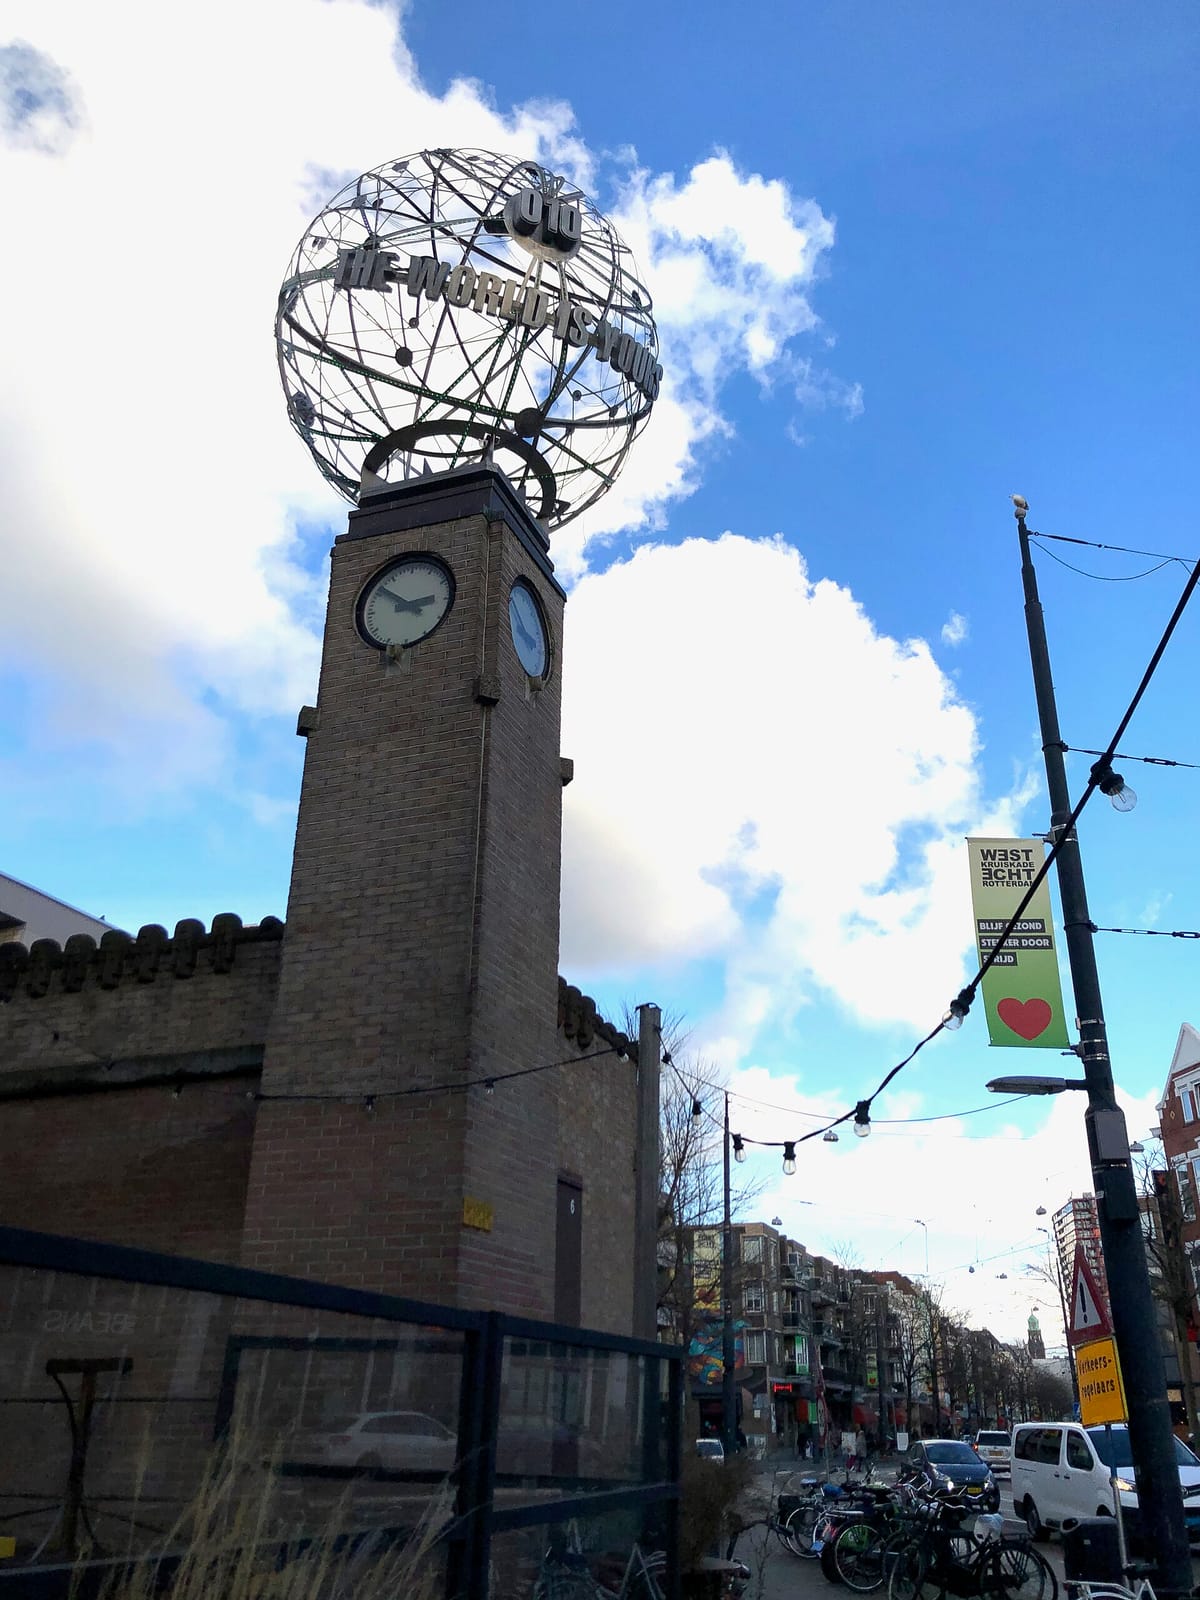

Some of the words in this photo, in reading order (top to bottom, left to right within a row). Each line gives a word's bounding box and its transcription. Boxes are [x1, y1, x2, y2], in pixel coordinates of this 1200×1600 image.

[515, 187, 582, 250] 010
[334, 248, 400, 293] THE
[407, 255, 548, 329] WORLD
[553, 300, 593, 348] IS
[594, 319, 664, 402] YOURS
[979, 922, 1004, 930] BLIJF
[981, 938, 1020, 946] STEKER
[1022, 938, 1050, 946] DOOR
[983, 955, 1014, 963] SRIJD
[570, 1199, 575, 1215] 6
